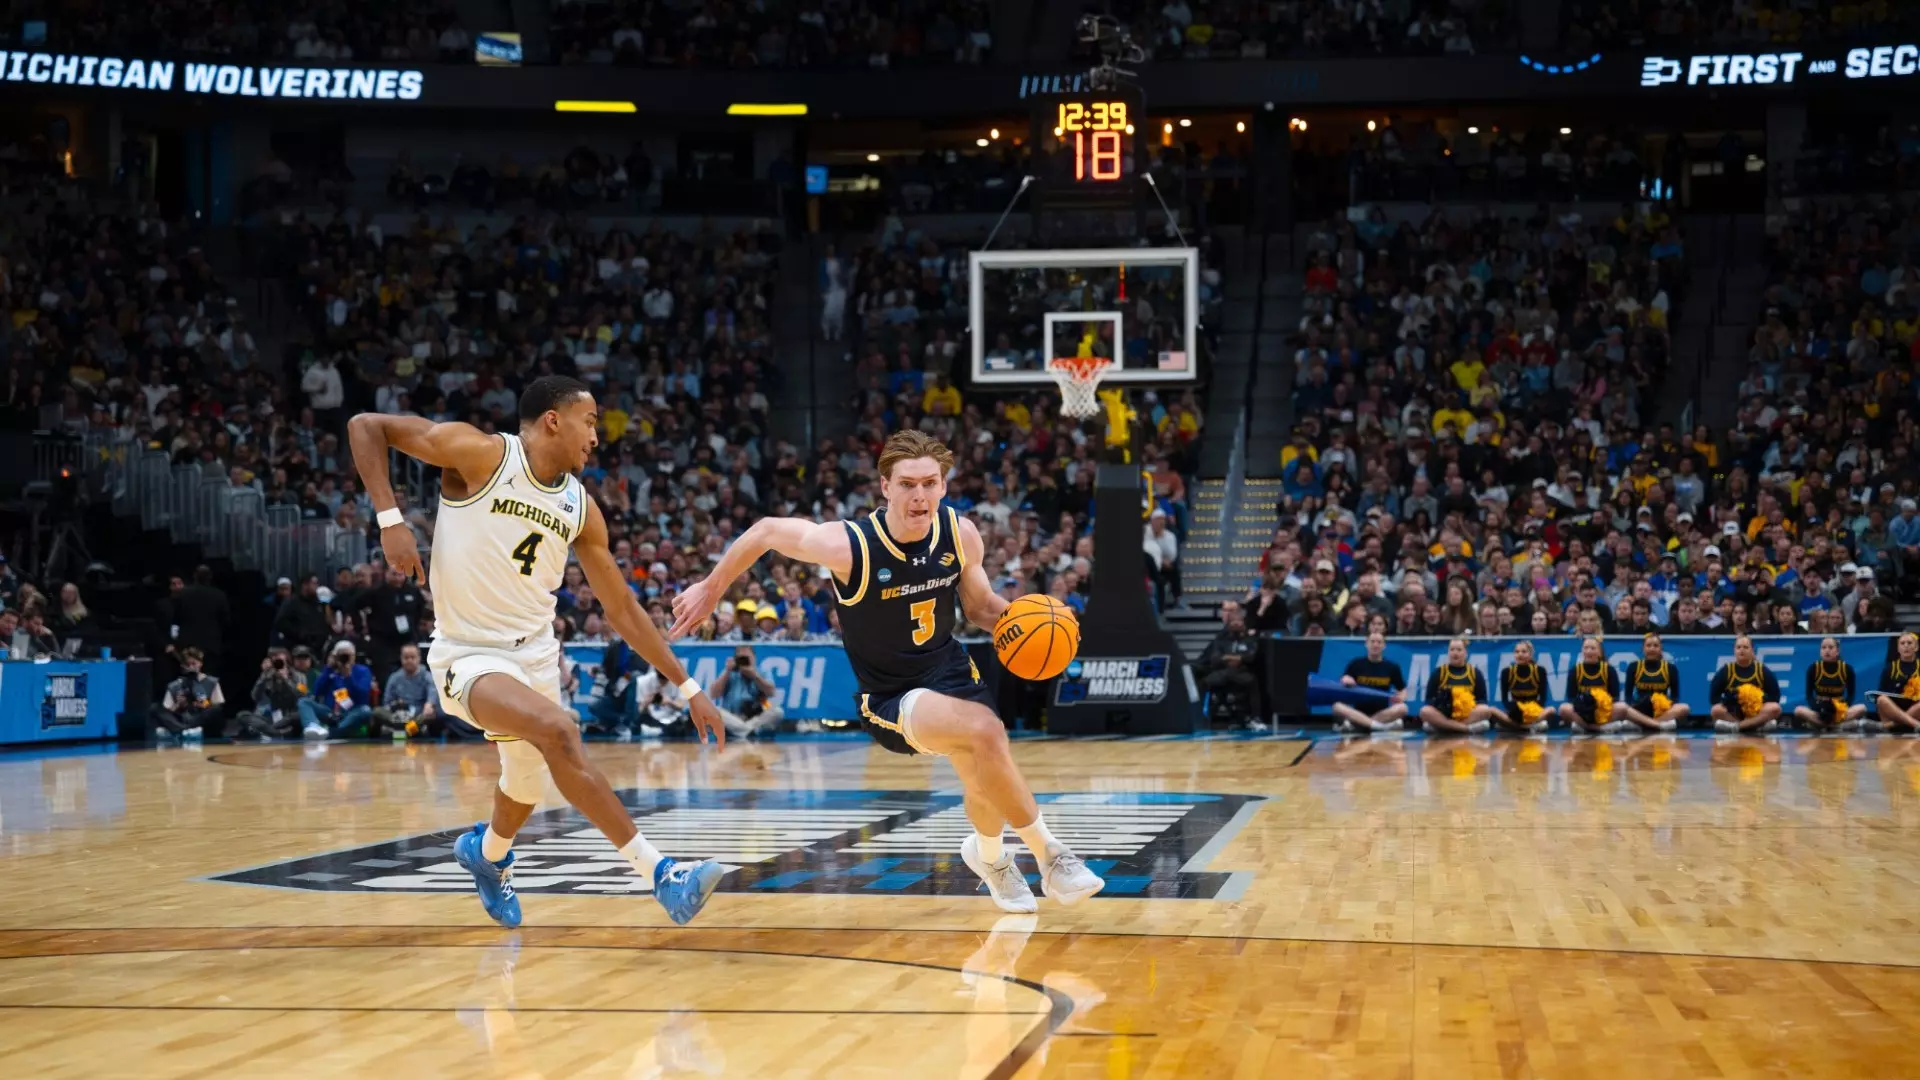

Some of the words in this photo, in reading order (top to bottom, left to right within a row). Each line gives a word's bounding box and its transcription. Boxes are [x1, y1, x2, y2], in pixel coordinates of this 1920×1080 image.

[184, 63, 424, 100] WOLVERINES
[1687, 53, 1803, 85] FIRST
[1808, 60, 1837, 74] AND
[1845, 45, 1920, 78] SEC
[1058, 102, 1127, 131] 12:39
[1074, 131, 1122, 181] 18
[490, 498, 571, 543] MICHIGAN
[512, 531, 544, 576] 4
[909, 598, 937, 647] 3
[1081, 660, 1139, 679] MARCH
[1087, 677, 1165, 696] MADNESS
